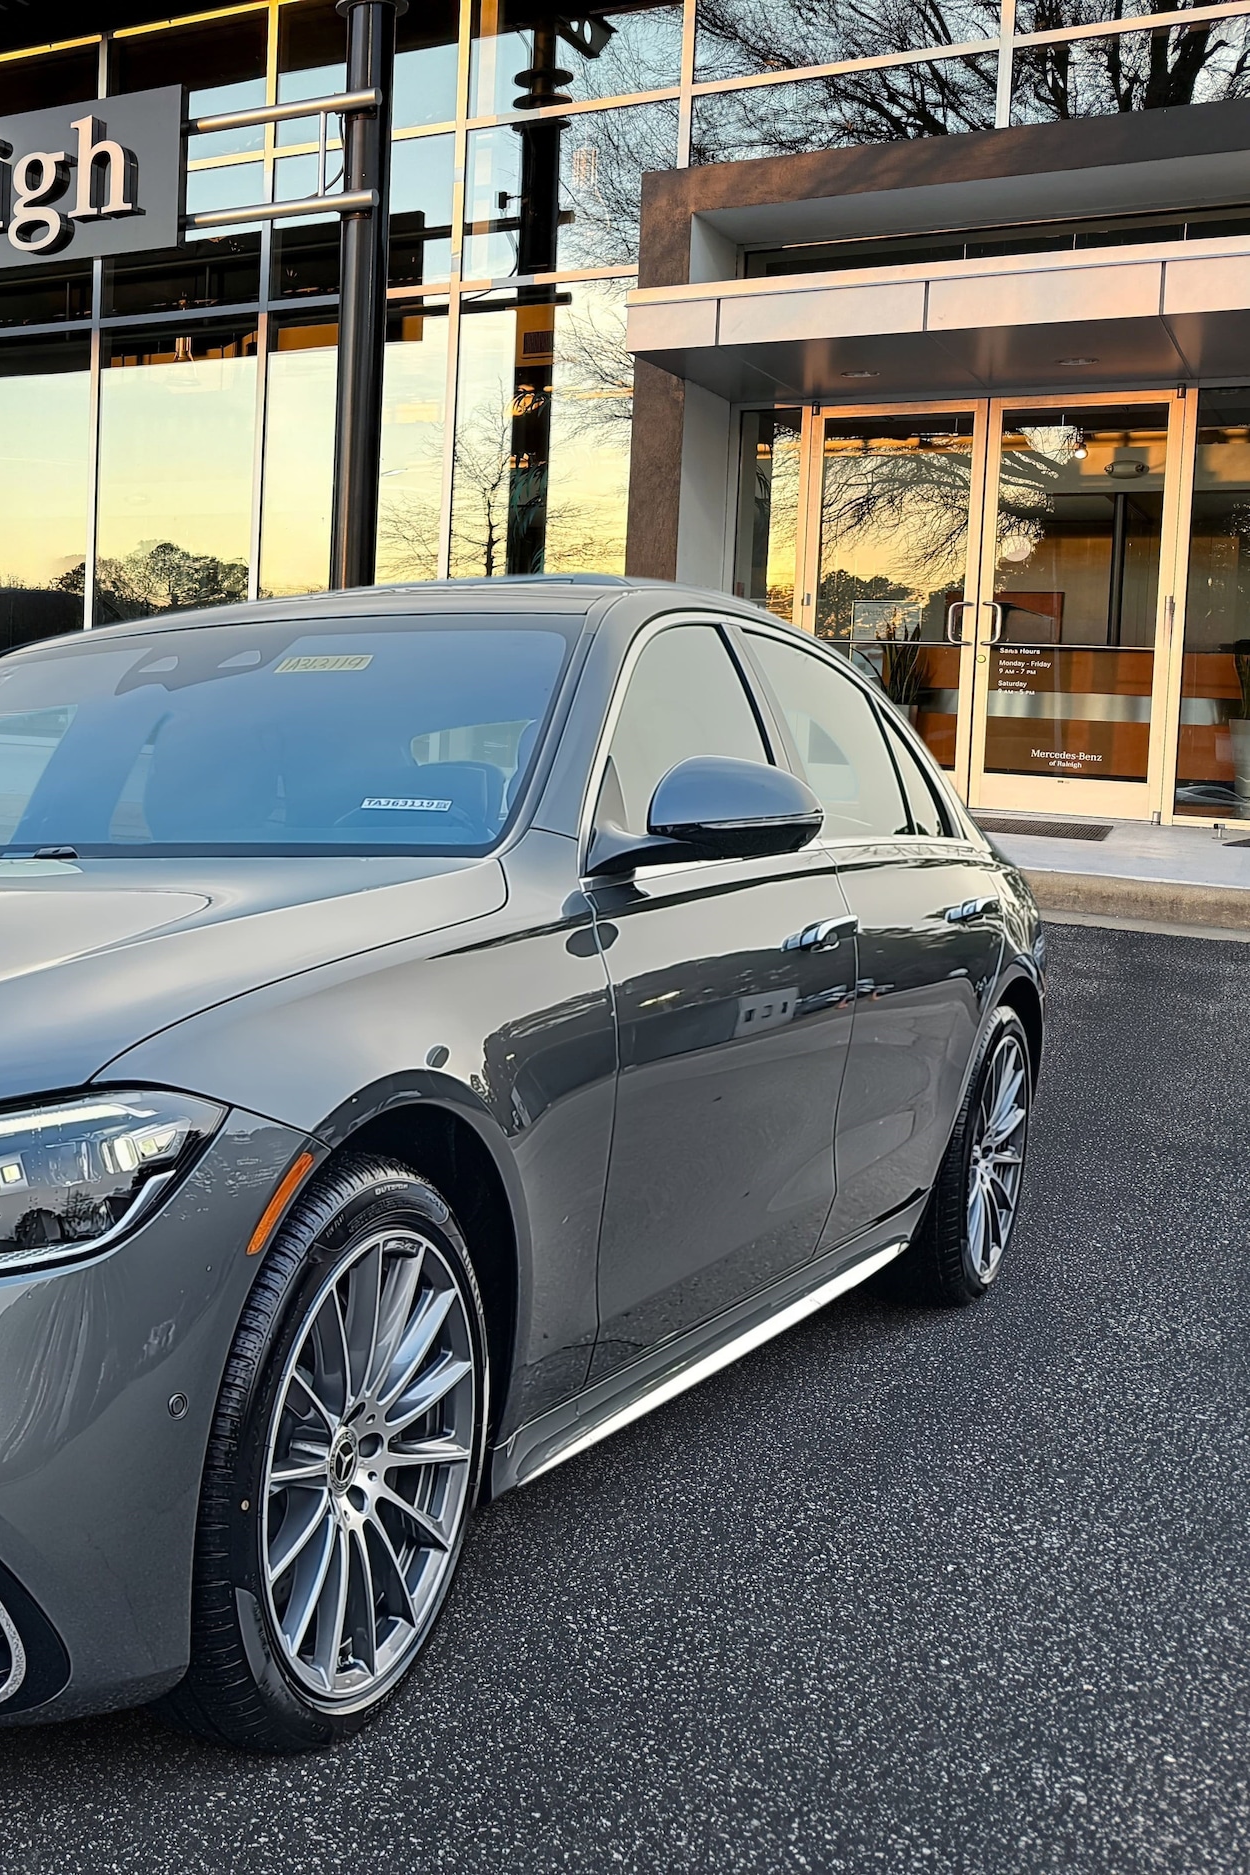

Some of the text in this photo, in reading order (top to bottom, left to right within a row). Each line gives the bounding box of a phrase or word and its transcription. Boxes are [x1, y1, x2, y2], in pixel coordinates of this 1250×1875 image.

[998, 660, 1026, 668] Monday
[997, 680, 1028, 688] Saturday
[1030, 749, 1103, 762] Mercedes-Benz
